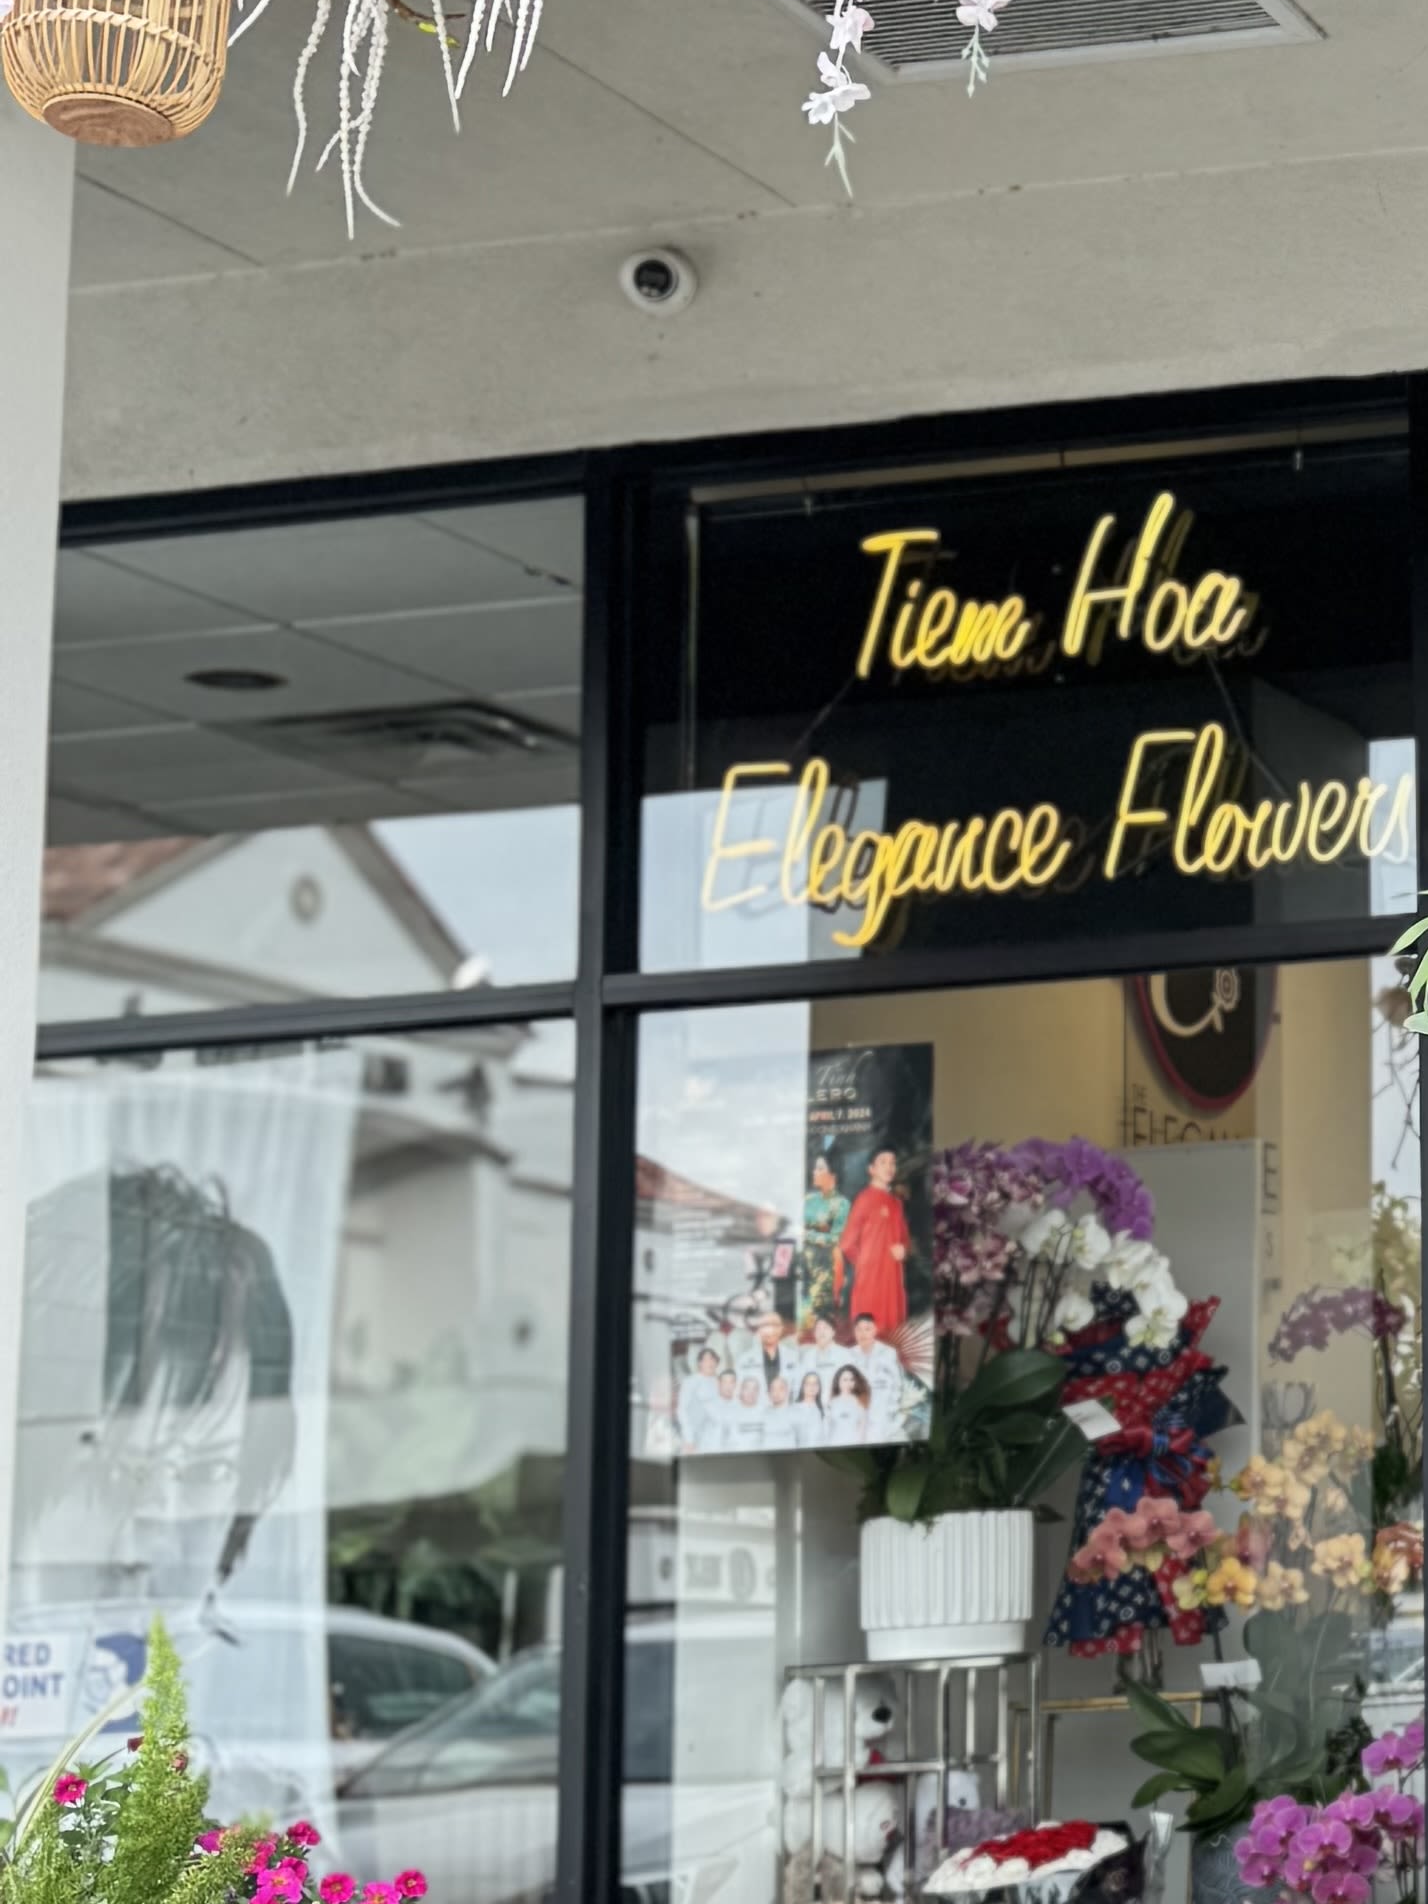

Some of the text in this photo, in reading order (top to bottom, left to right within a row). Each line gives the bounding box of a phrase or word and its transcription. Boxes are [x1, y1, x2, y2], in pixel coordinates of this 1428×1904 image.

[1062, 491, 1252, 658] Hoa
[701, 722, 1418, 948] Elegance Flowers
